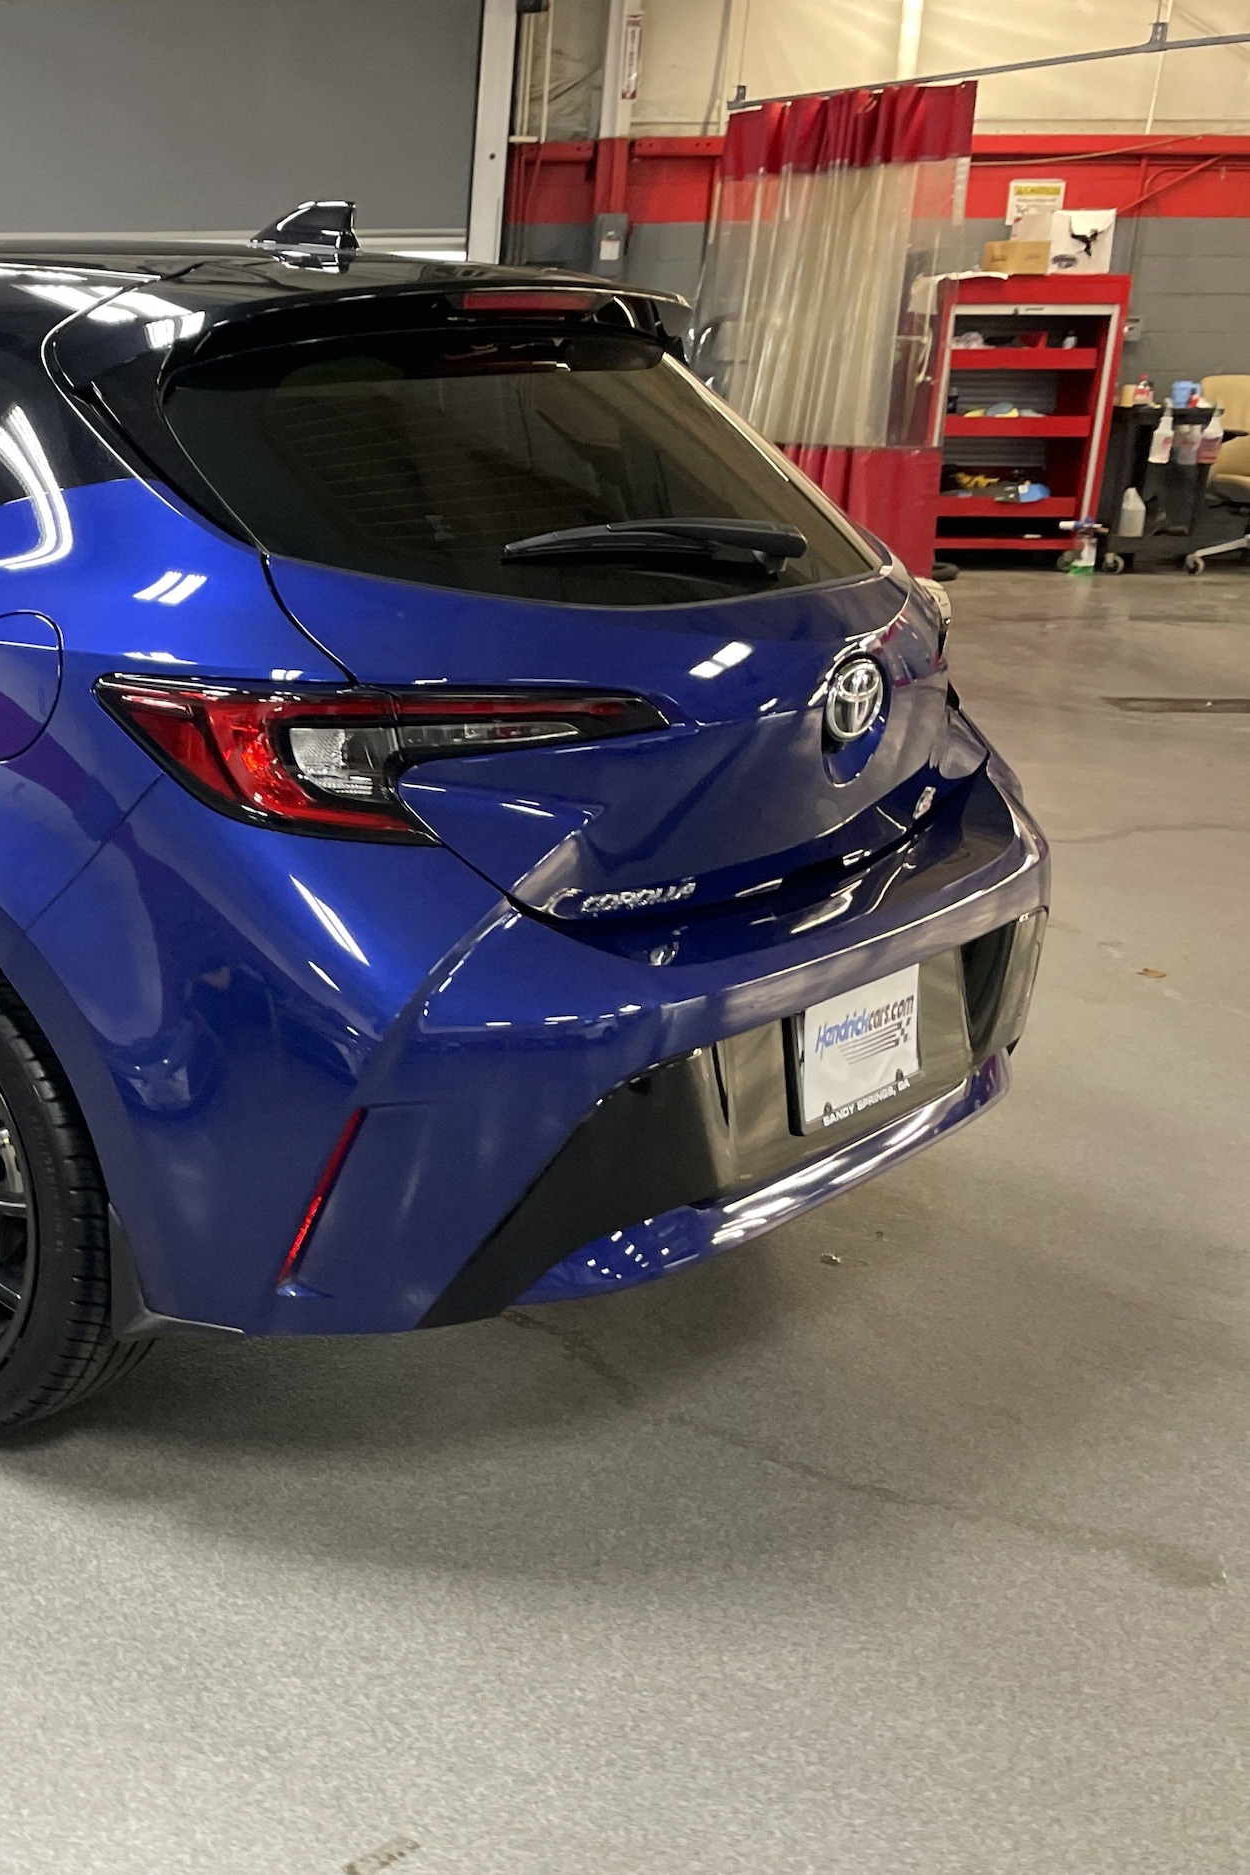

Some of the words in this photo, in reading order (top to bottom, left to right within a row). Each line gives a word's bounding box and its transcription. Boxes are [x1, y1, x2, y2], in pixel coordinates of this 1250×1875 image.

[580, 882, 697, 915] COROLLA
[814, 995, 915, 1060] Hendrickcars.com
[822, 1103, 855, 1127] SANDY
[856, 1085, 897, 1111] SPRINGS,
[897, 1078, 911, 1092] GA
